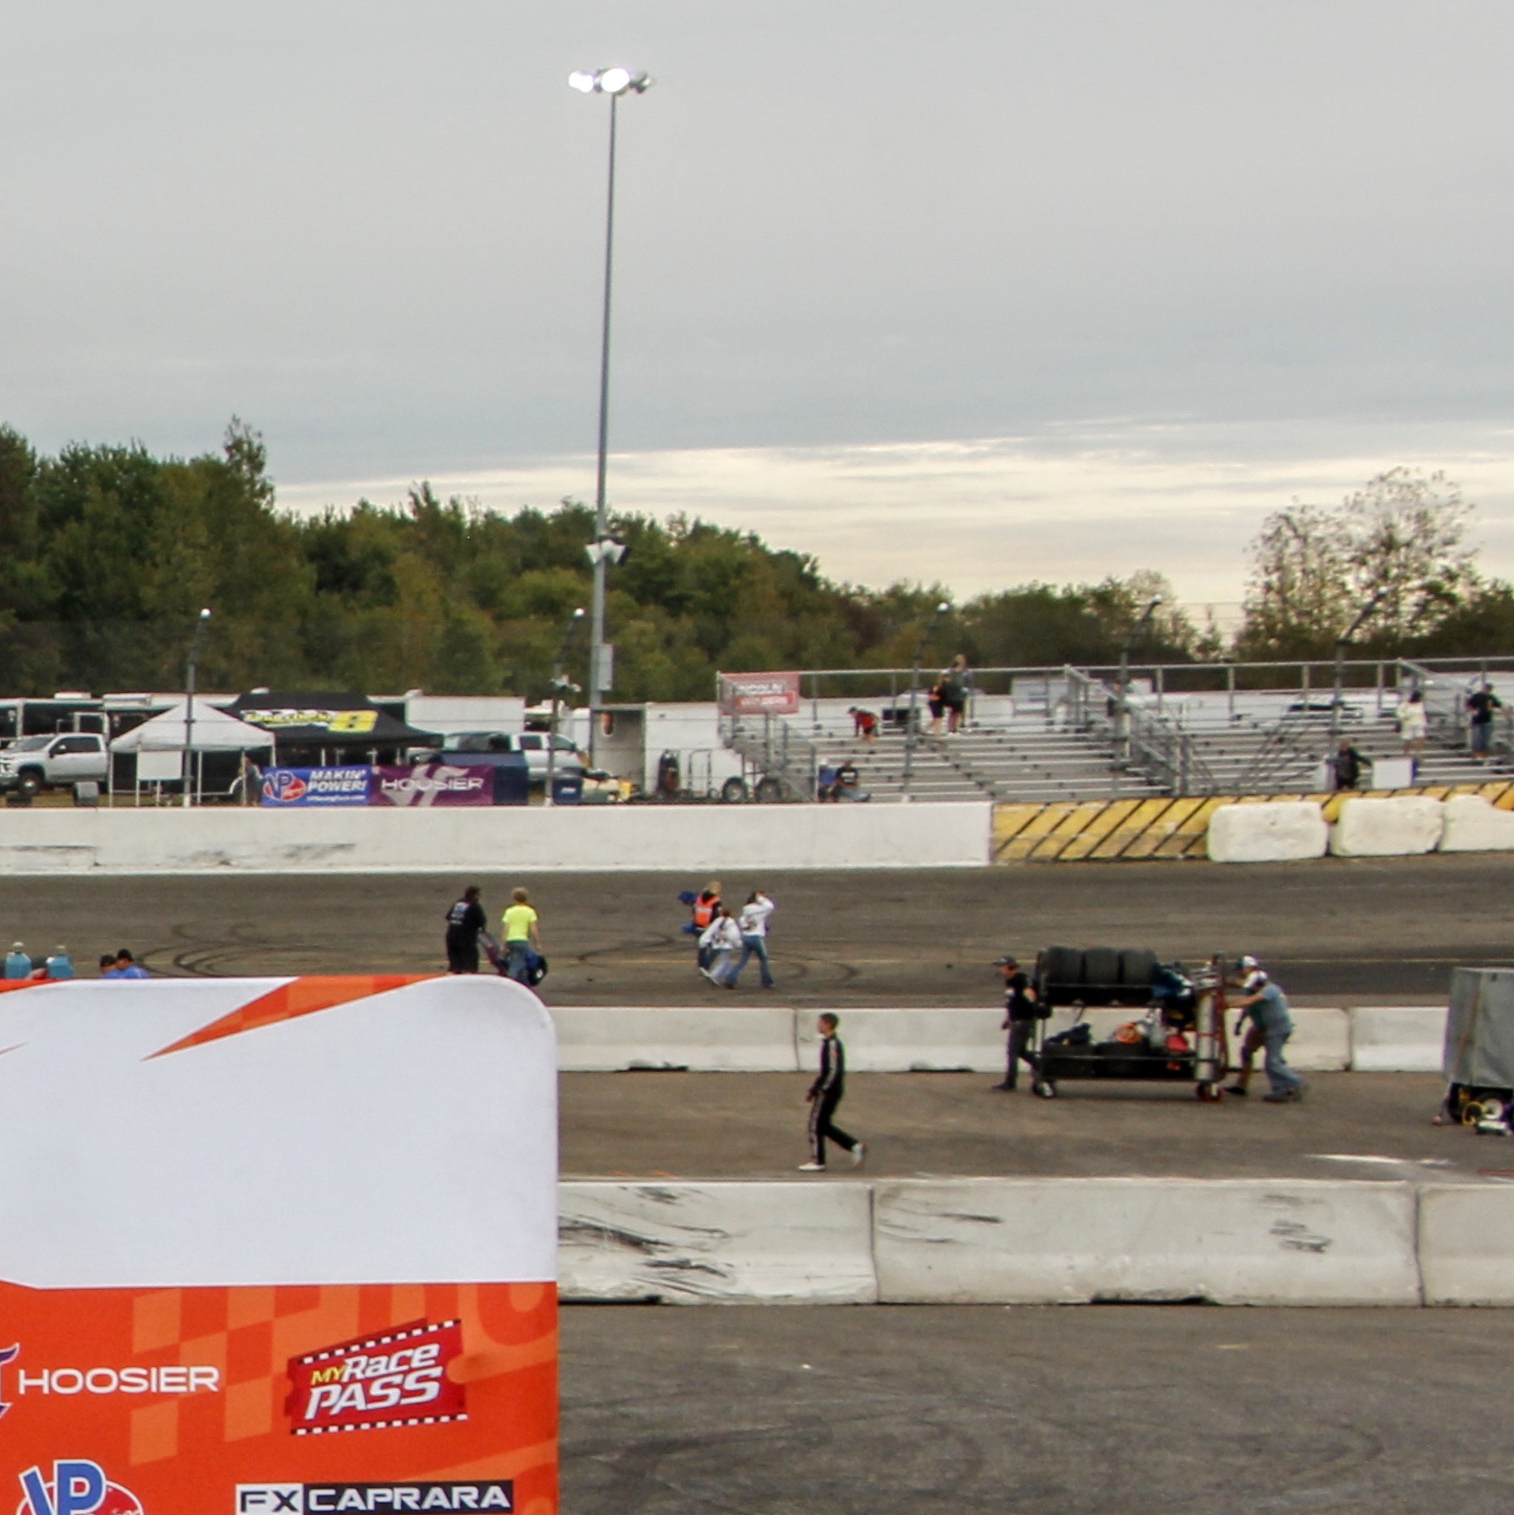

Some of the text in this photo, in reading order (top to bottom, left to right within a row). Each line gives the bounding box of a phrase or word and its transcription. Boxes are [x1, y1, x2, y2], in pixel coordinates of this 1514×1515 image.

[304, 1369, 445, 1420] PASS
[240, 1485, 511, 1514] FX CAPRARA
